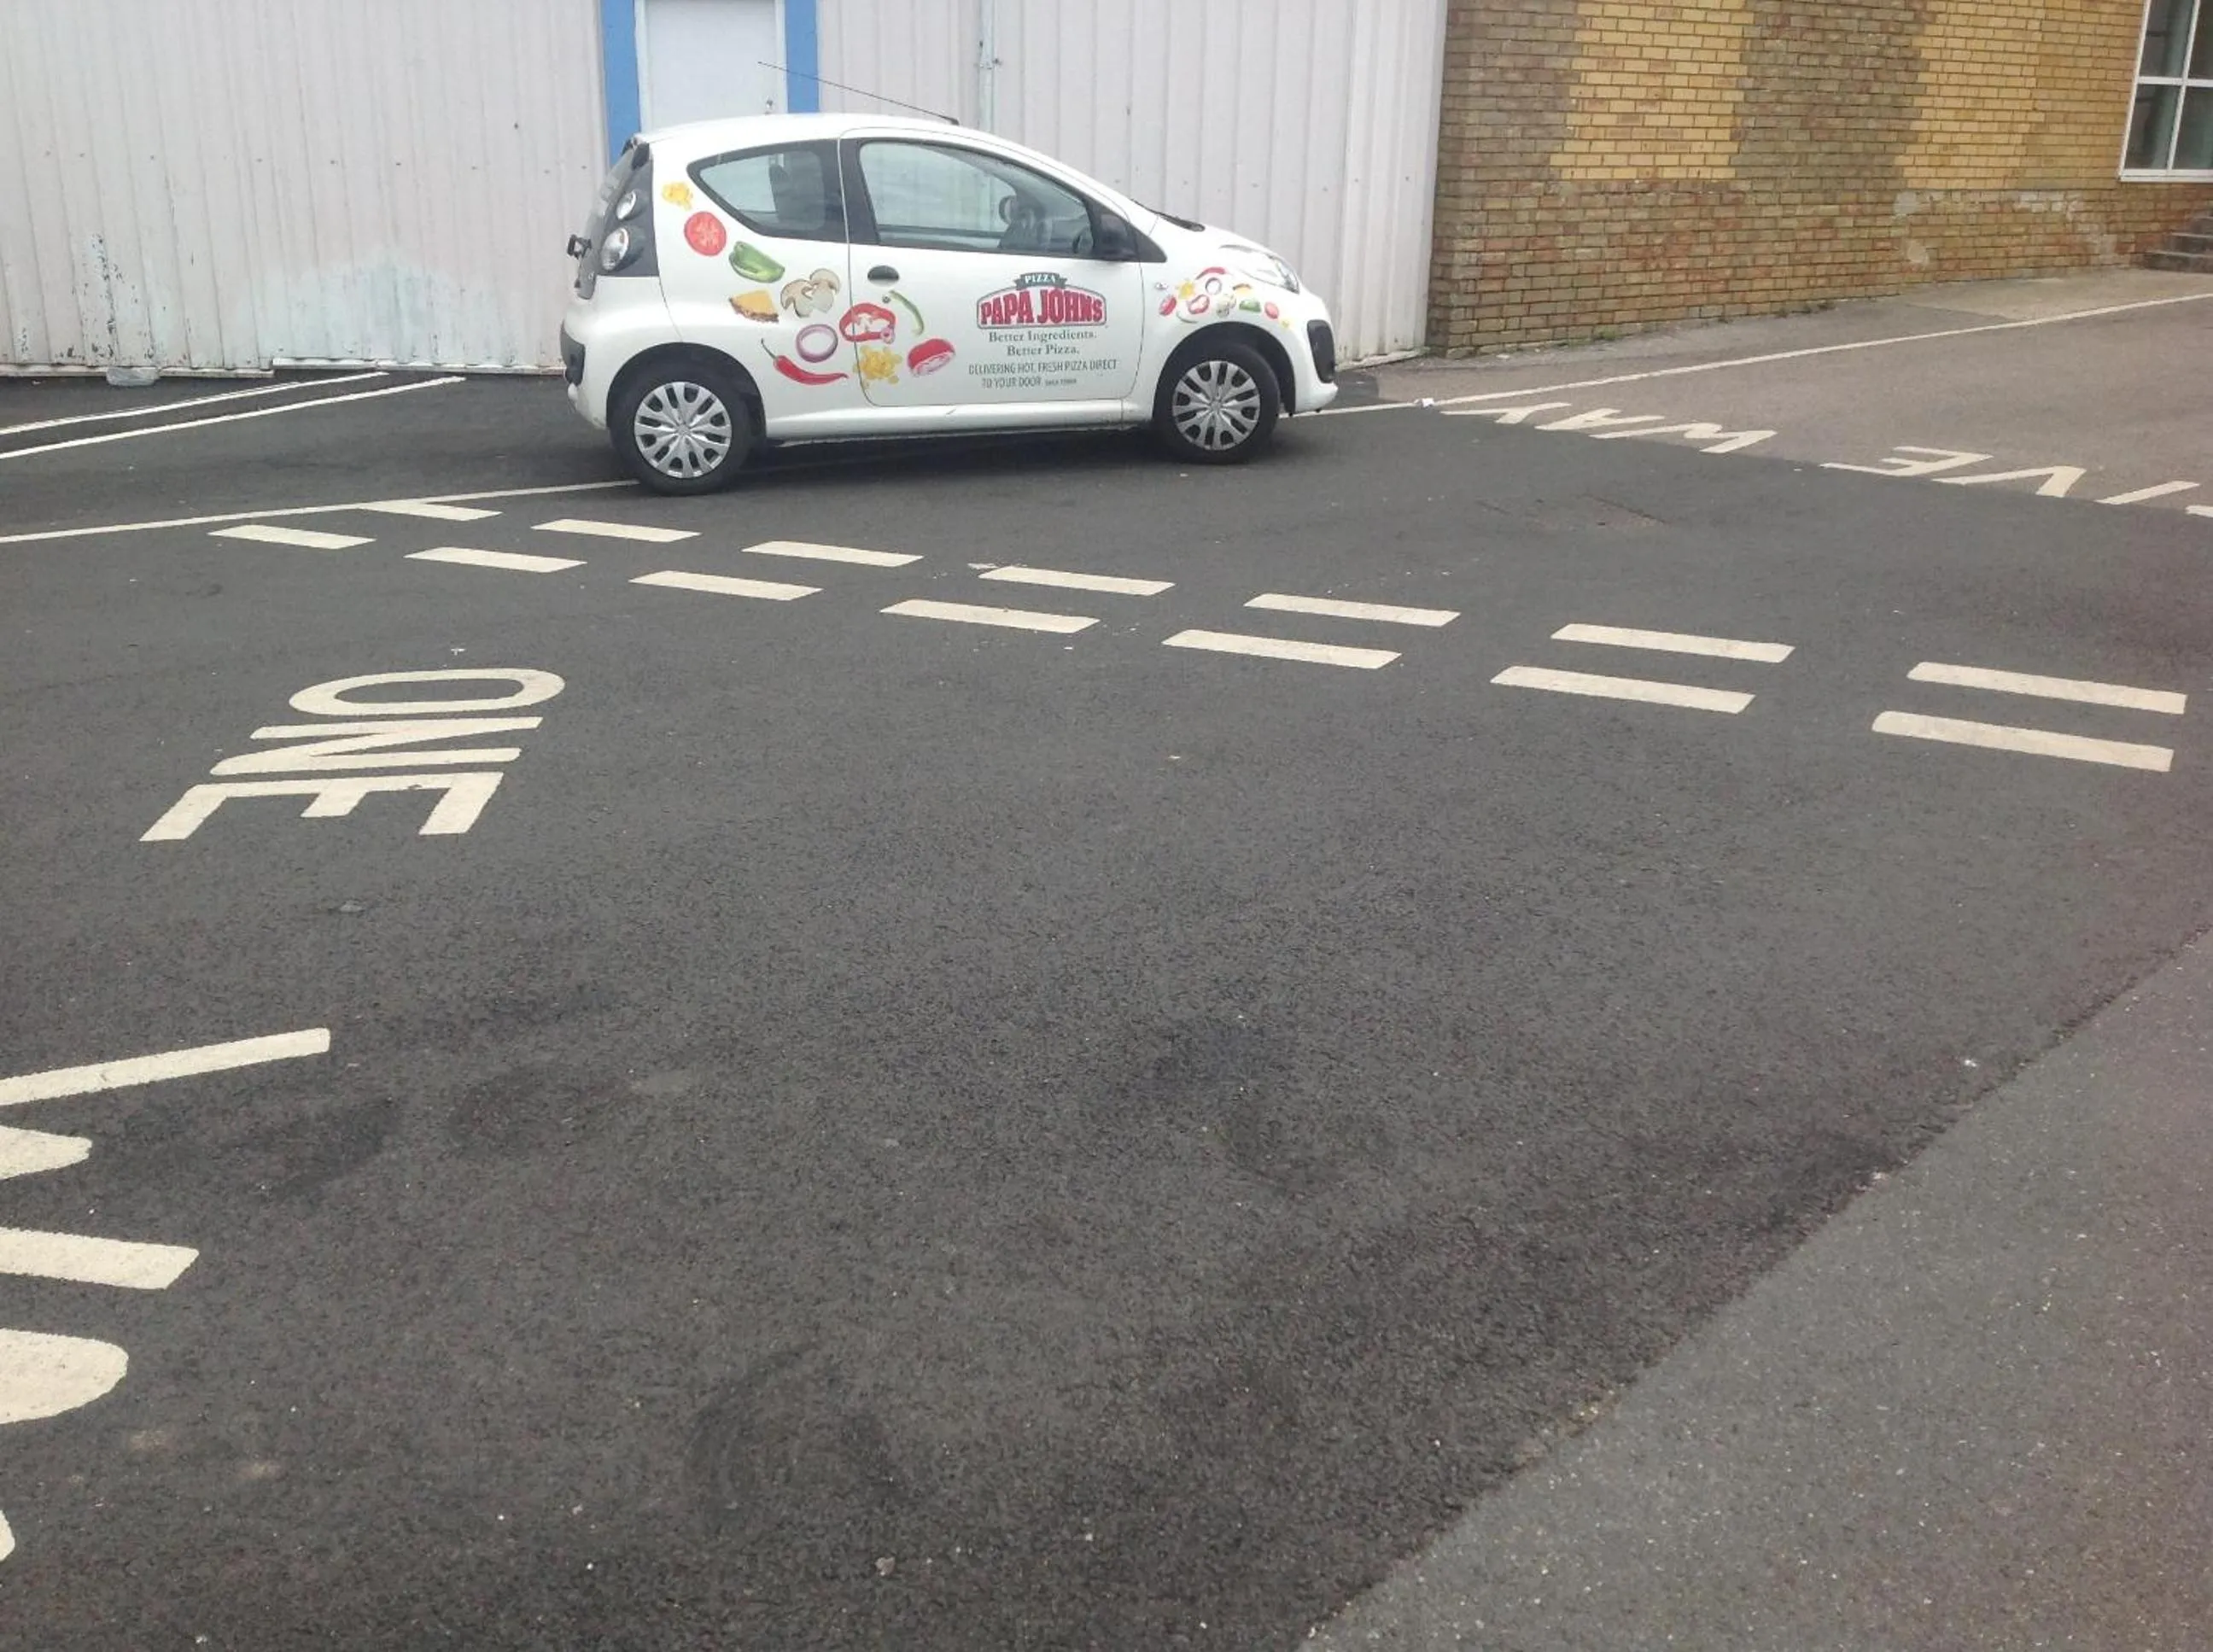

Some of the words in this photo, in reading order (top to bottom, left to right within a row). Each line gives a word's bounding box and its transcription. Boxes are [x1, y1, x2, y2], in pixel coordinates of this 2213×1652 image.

[1025, 273, 1056, 283] PIZZA
[980, 291, 1034, 324] PAPA
[989, 331, 1025, 342] Better
[1007, 345, 1042, 356] Better
[1037, 361, 1063, 372] FRESH
[1065, 359, 1088, 371] PIZZA
[1089, 359, 1117, 371] DIRECT
[994, 377, 1017, 388] YOUR
[139, 668, 565, 841] ONE
